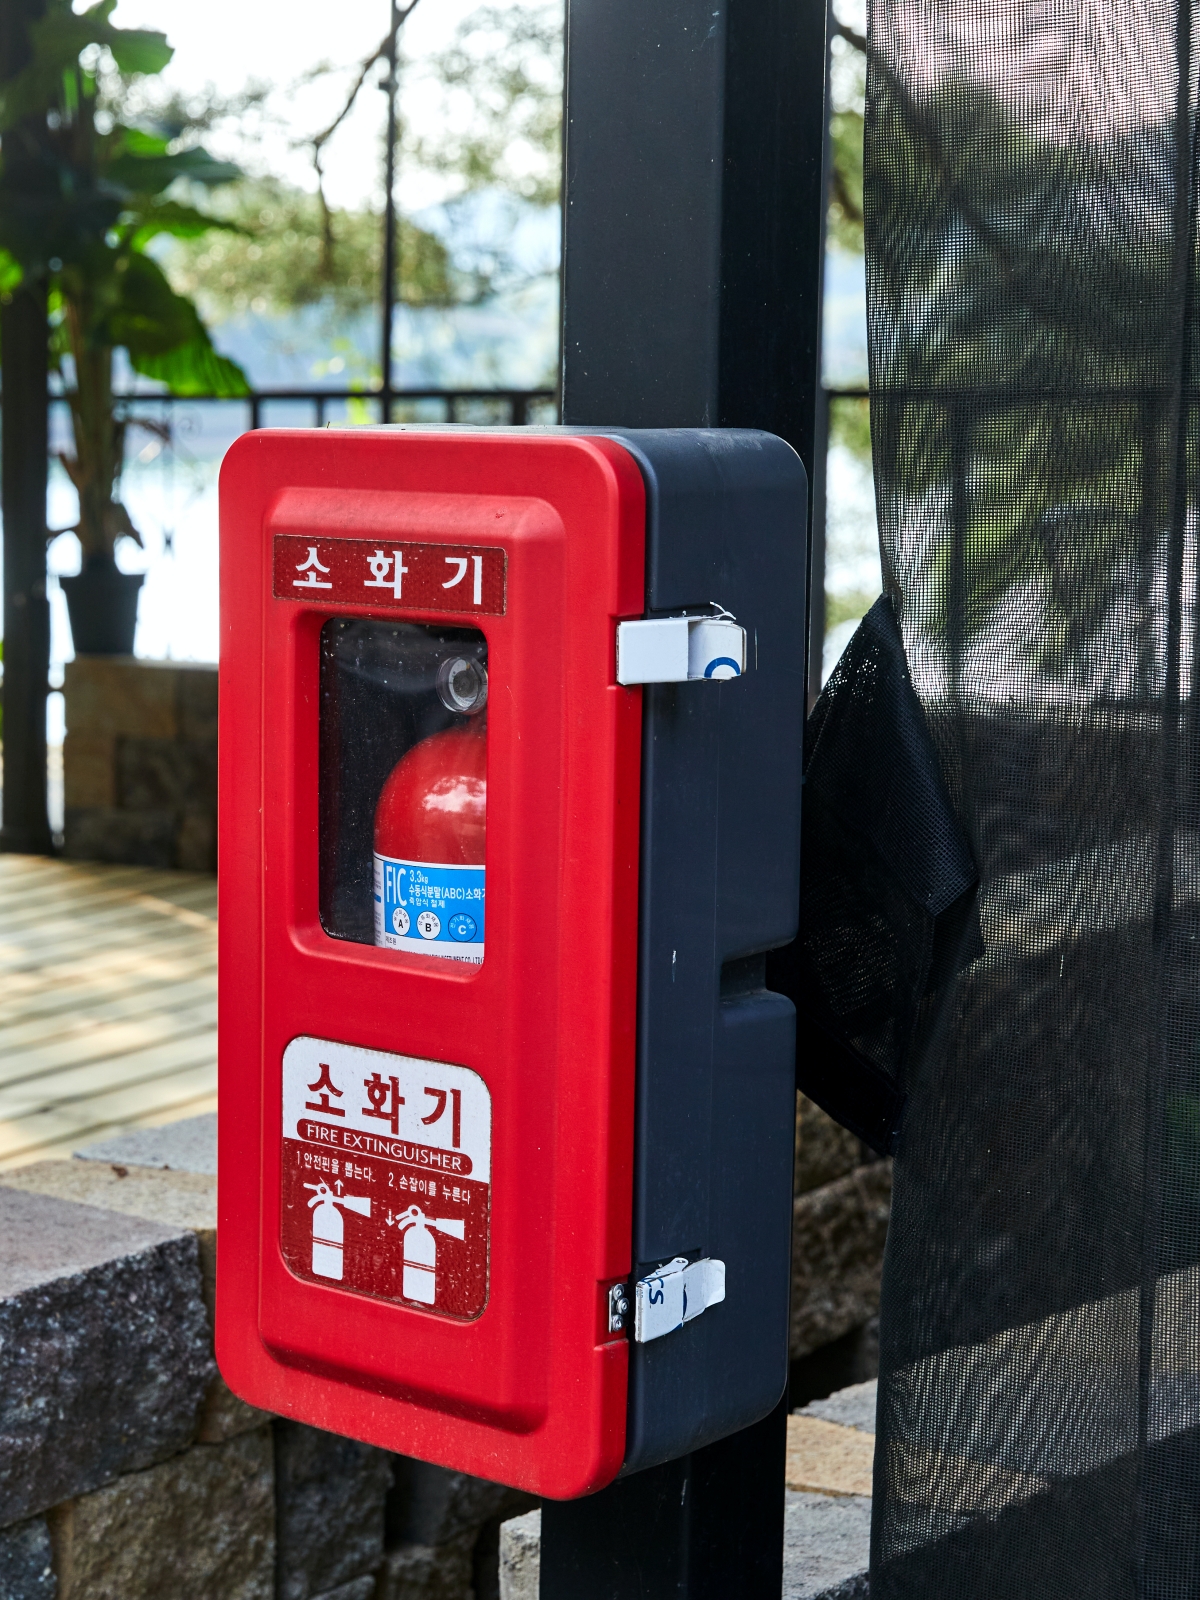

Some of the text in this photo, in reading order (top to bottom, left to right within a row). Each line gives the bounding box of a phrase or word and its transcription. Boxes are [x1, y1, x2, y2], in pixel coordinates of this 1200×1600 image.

[386, 865, 408, 906] FIC
[409, 869, 429, 885] 3.3kg
[398, 919, 404, 929] A
[425, 923, 432, 932] B
[458, 924, 467, 935] C
[305, 1062, 462, 1149] 소화기
[306, 1123, 463, 1171] FIRE EXTINGUISHER
[441, 1184, 471, 1205] 누른다
